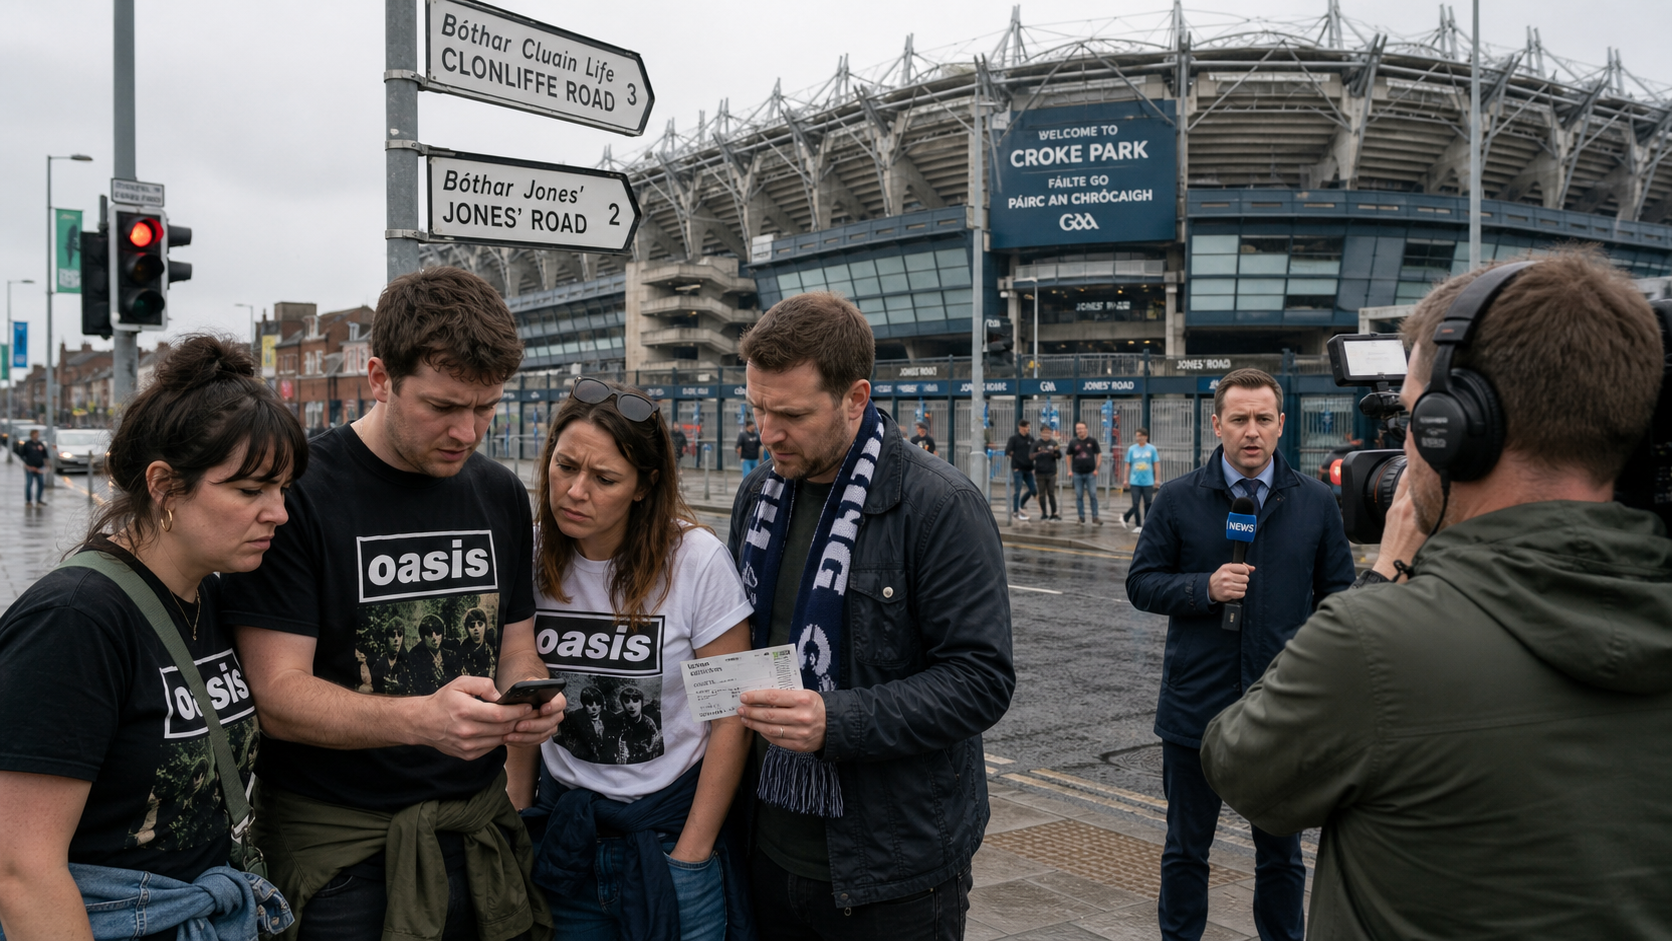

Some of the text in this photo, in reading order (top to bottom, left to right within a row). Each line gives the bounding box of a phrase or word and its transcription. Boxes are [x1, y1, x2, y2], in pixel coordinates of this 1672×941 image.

[441, 13, 614, 84] Bóthar Cluain Life
[441, 47, 615, 112] CLONLIFFE ROAD
[626, 83, 637, 106] 3
[1038, 125, 1118, 140] WELCOME TO
[1010, 140, 1149, 168] CROKE PARK
[443, 170, 584, 204] Bóthar Jones'
[1048, 175, 1109, 188] FÁILTE GO
[1008, 189, 1153, 209] PÁIRC AN CHRÓCAIGH
[442, 202, 587, 234] JONES' ROAD
[609, 203, 620, 226] 2
[1059, 212, 1100, 231] GAA
[1111, 381, 1134, 390] ROAD
[1229, 521, 1255, 533] NEWS
[368, 539, 490, 586] oasis
[536, 625, 652, 662] oasis
